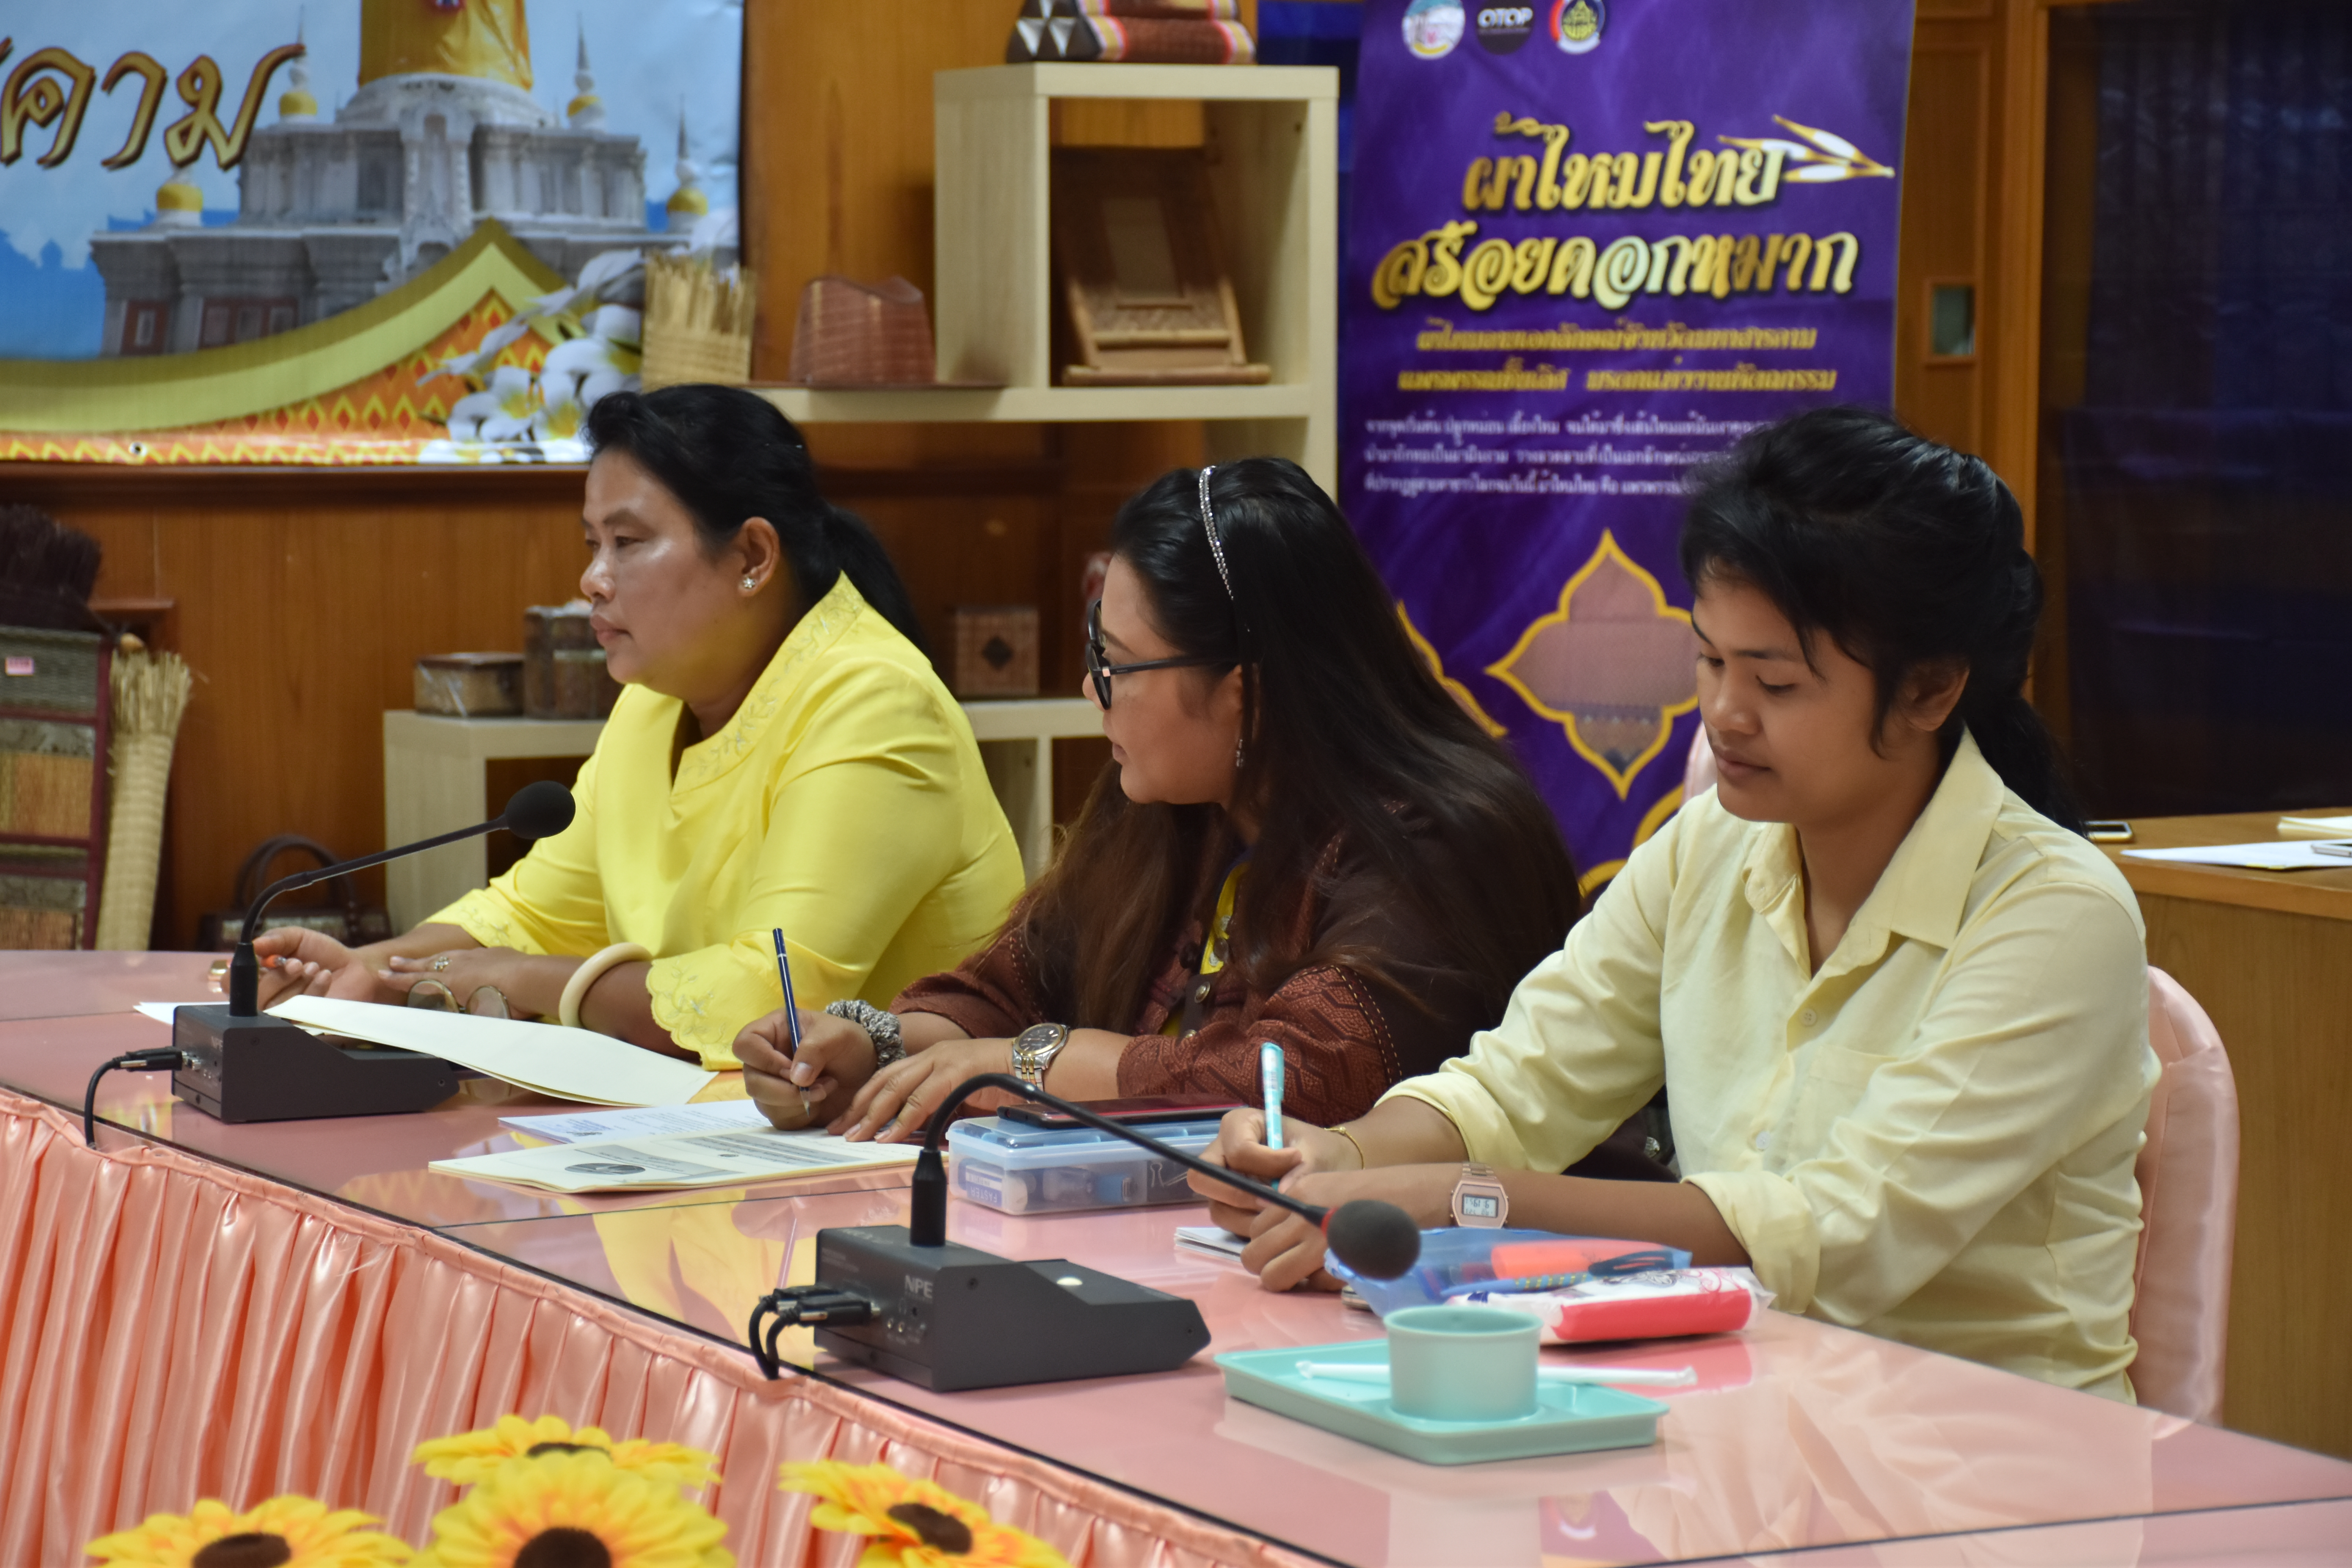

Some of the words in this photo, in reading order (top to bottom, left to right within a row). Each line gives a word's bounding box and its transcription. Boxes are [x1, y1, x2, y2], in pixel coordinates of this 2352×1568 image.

[1477, 7, 1534, 27] OTOP
[0, 37, 306, 171] คาม
[1461, 111, 1788, 210] ผ้าไหมไทย
[1371, 220, 1859, 310] สร้อยดอกหมาก
[971, 1187, 998, 1203] FASTER
[905, 1274, 934, 1298] NPE
